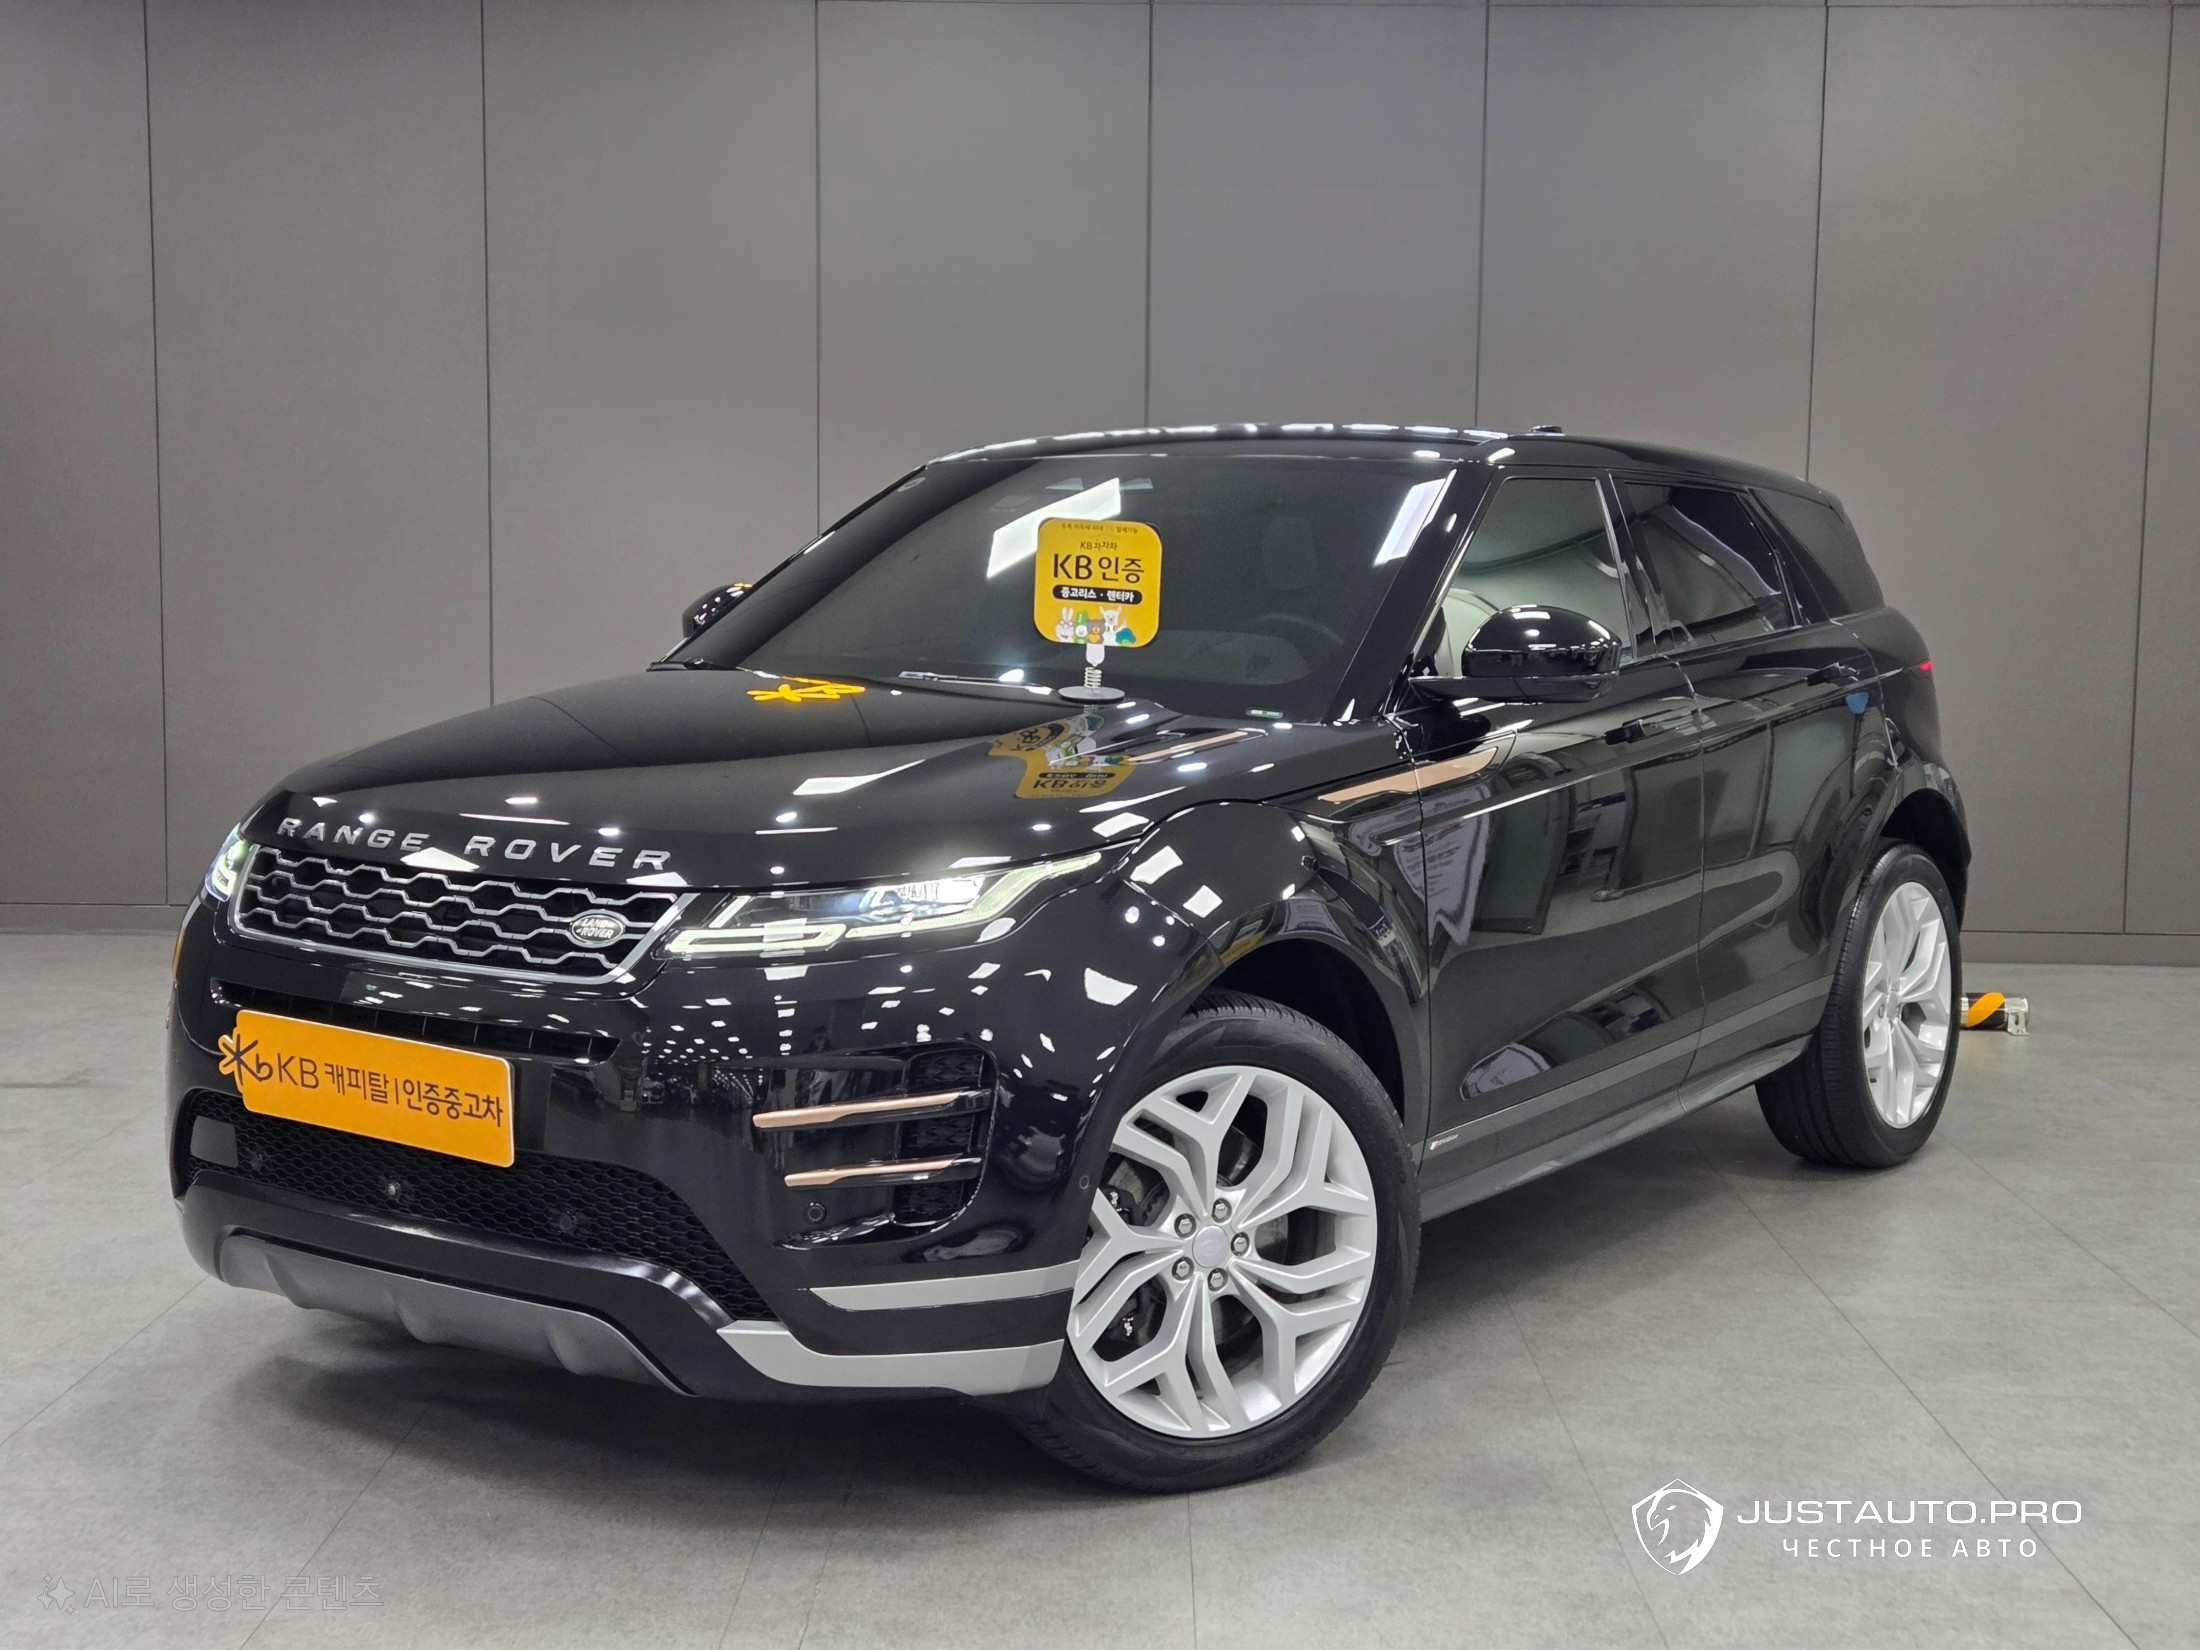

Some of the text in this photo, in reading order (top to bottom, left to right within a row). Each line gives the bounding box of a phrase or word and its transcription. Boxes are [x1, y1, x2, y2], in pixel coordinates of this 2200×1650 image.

[1060, 586, 1135, 603] 중고리스 렌터카
[276, 817, 672, 871] RANGE ROVER
[581, 918, 609, 928] LAND
[580, 927, 615, 939] ROVER
